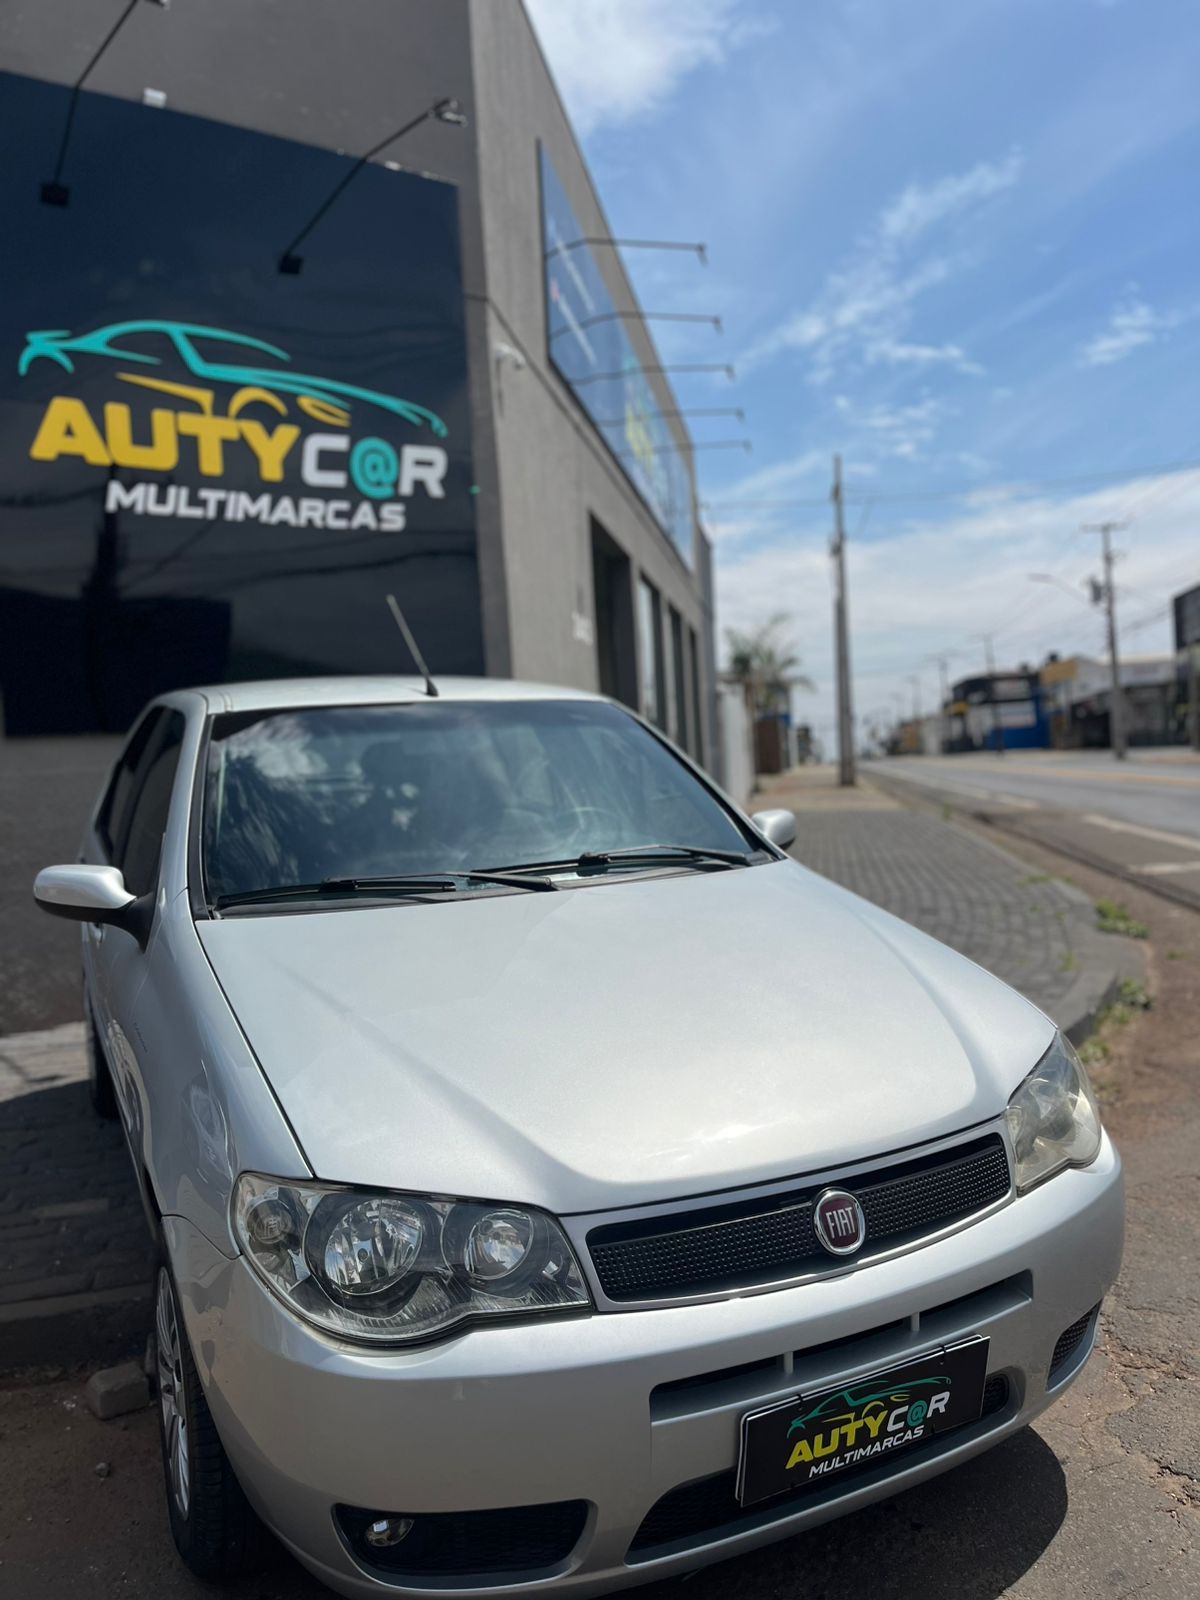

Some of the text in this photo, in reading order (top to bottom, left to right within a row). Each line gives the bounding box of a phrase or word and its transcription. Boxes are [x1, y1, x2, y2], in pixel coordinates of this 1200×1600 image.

[105, 480, 407, 533] MULTIMARCAS
[825, 1206, 857, 1239] FIAT
[809, 1424, 924, 1478] MULTIMARCAS
